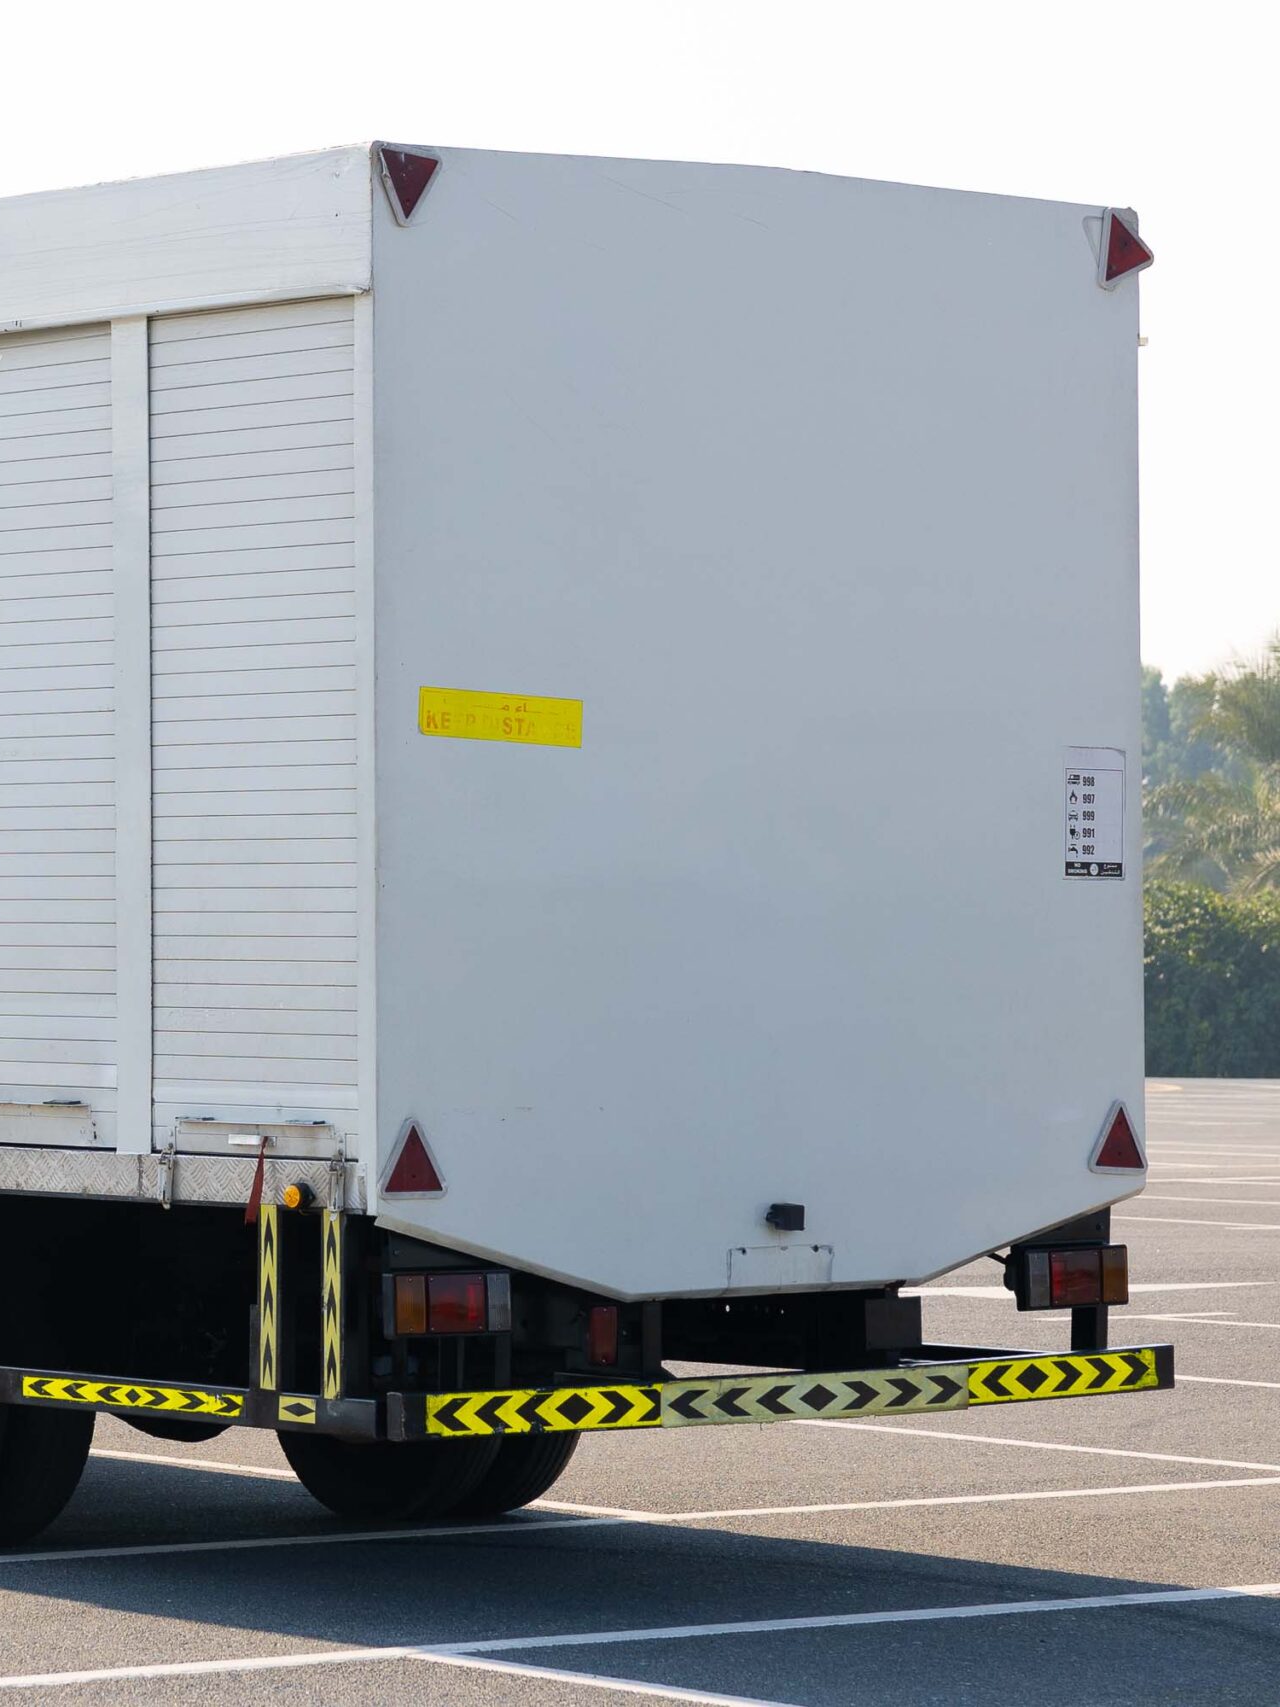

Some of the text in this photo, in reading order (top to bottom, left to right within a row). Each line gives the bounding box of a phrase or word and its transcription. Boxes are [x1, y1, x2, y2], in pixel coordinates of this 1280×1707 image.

[1082, 776, 1095, 787] 998
[1082, 793, 1095, 804] 997
[1082, 810, 1095, 821] 999
[1082, 827, 1095, 838] 991
[1082, 844, 1095, 855] 992
